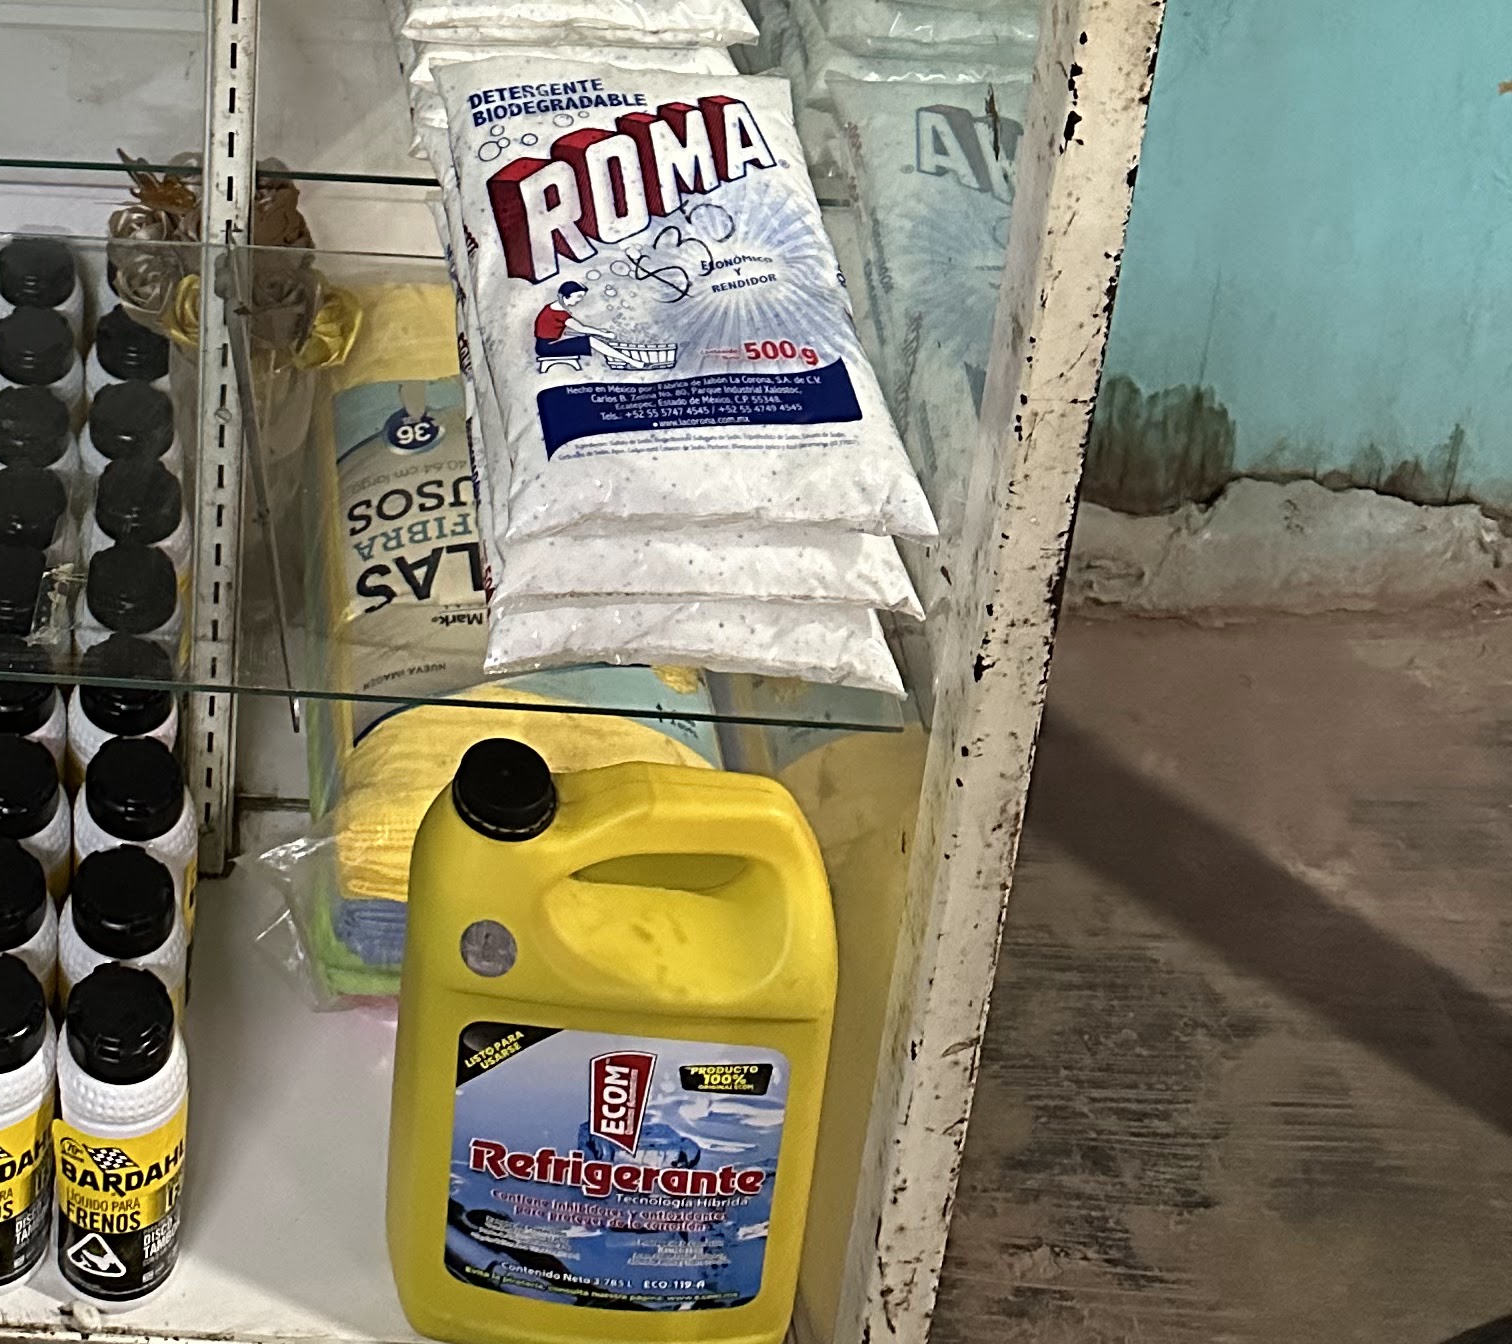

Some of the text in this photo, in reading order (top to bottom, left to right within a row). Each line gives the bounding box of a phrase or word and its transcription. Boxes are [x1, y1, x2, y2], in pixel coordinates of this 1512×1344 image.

[467, 77, 605, 111] DETERGENTE
[471, 92, 648, 128] BIODEGRADABLE
[486, 95, 779, 285] ROMA
[711, 273, 778, 294] RENDIDOR
[743, 340, 820, 366] 500 g
[395, 420, 430, 445] 36
[464, 1030, 525, 1068] LISTO PARA
[479, 1042, 522, 1070] USARSE
[690, 1065, 759, 1076] PRODUCTO
[703, 1074, 746, 1086] 100%
[600, 1065, 630, 1137] ECOM
[60, 1135, 186, 1197] BARDAHL
[469, 1138, 766, 1198] Refrigerante
[66, 1188, 141, 1212] LÍQUIDO PARA
[616, 1193, 750, 1209] Tecnología Híbrida
[66, 1201, 141, 1234] FRENOS
[501, 1261, 591, 1285] Contenido Neto
